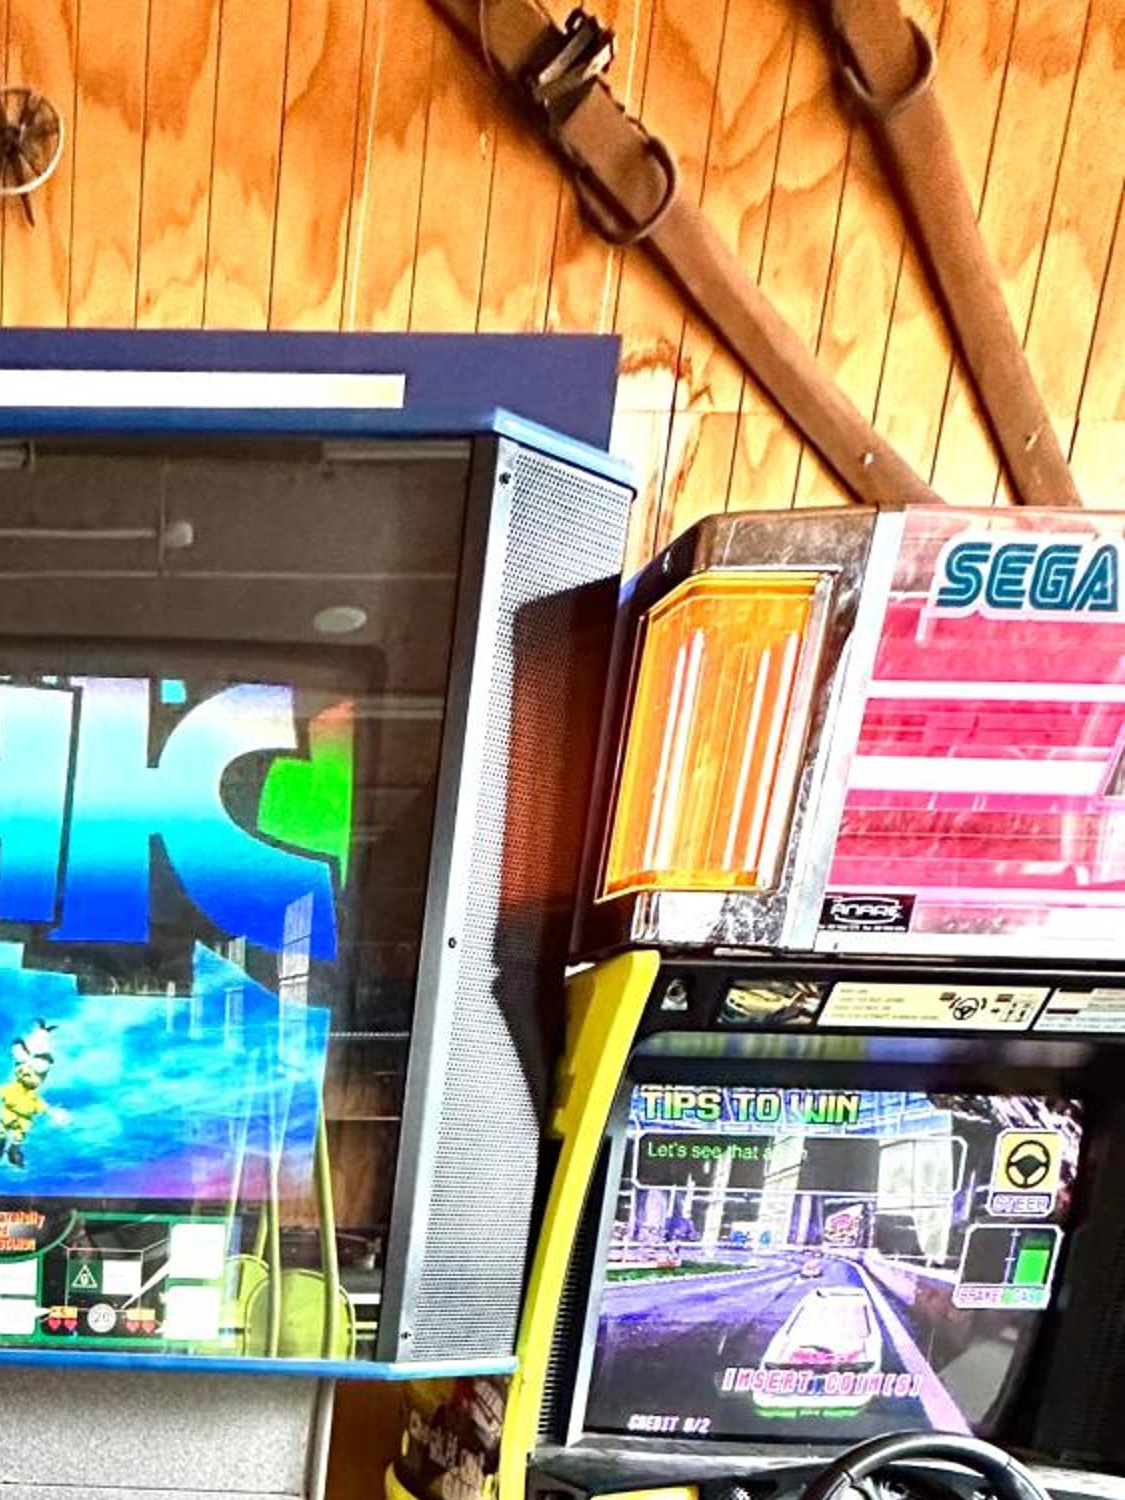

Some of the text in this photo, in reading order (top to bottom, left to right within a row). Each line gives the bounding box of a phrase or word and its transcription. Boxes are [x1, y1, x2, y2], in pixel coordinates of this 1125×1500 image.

[937, 542, 1118, 612] SEGA
[640, 1088, 861, 1125] TIPS TO WIN
[648, 1141, 686, 1158] Let's
[692, 1144, 723, 1159] see
[721, 1367, 923, 1397] INSERT COIN(S)
[627, 1412, 679, 1434] CREDIT
